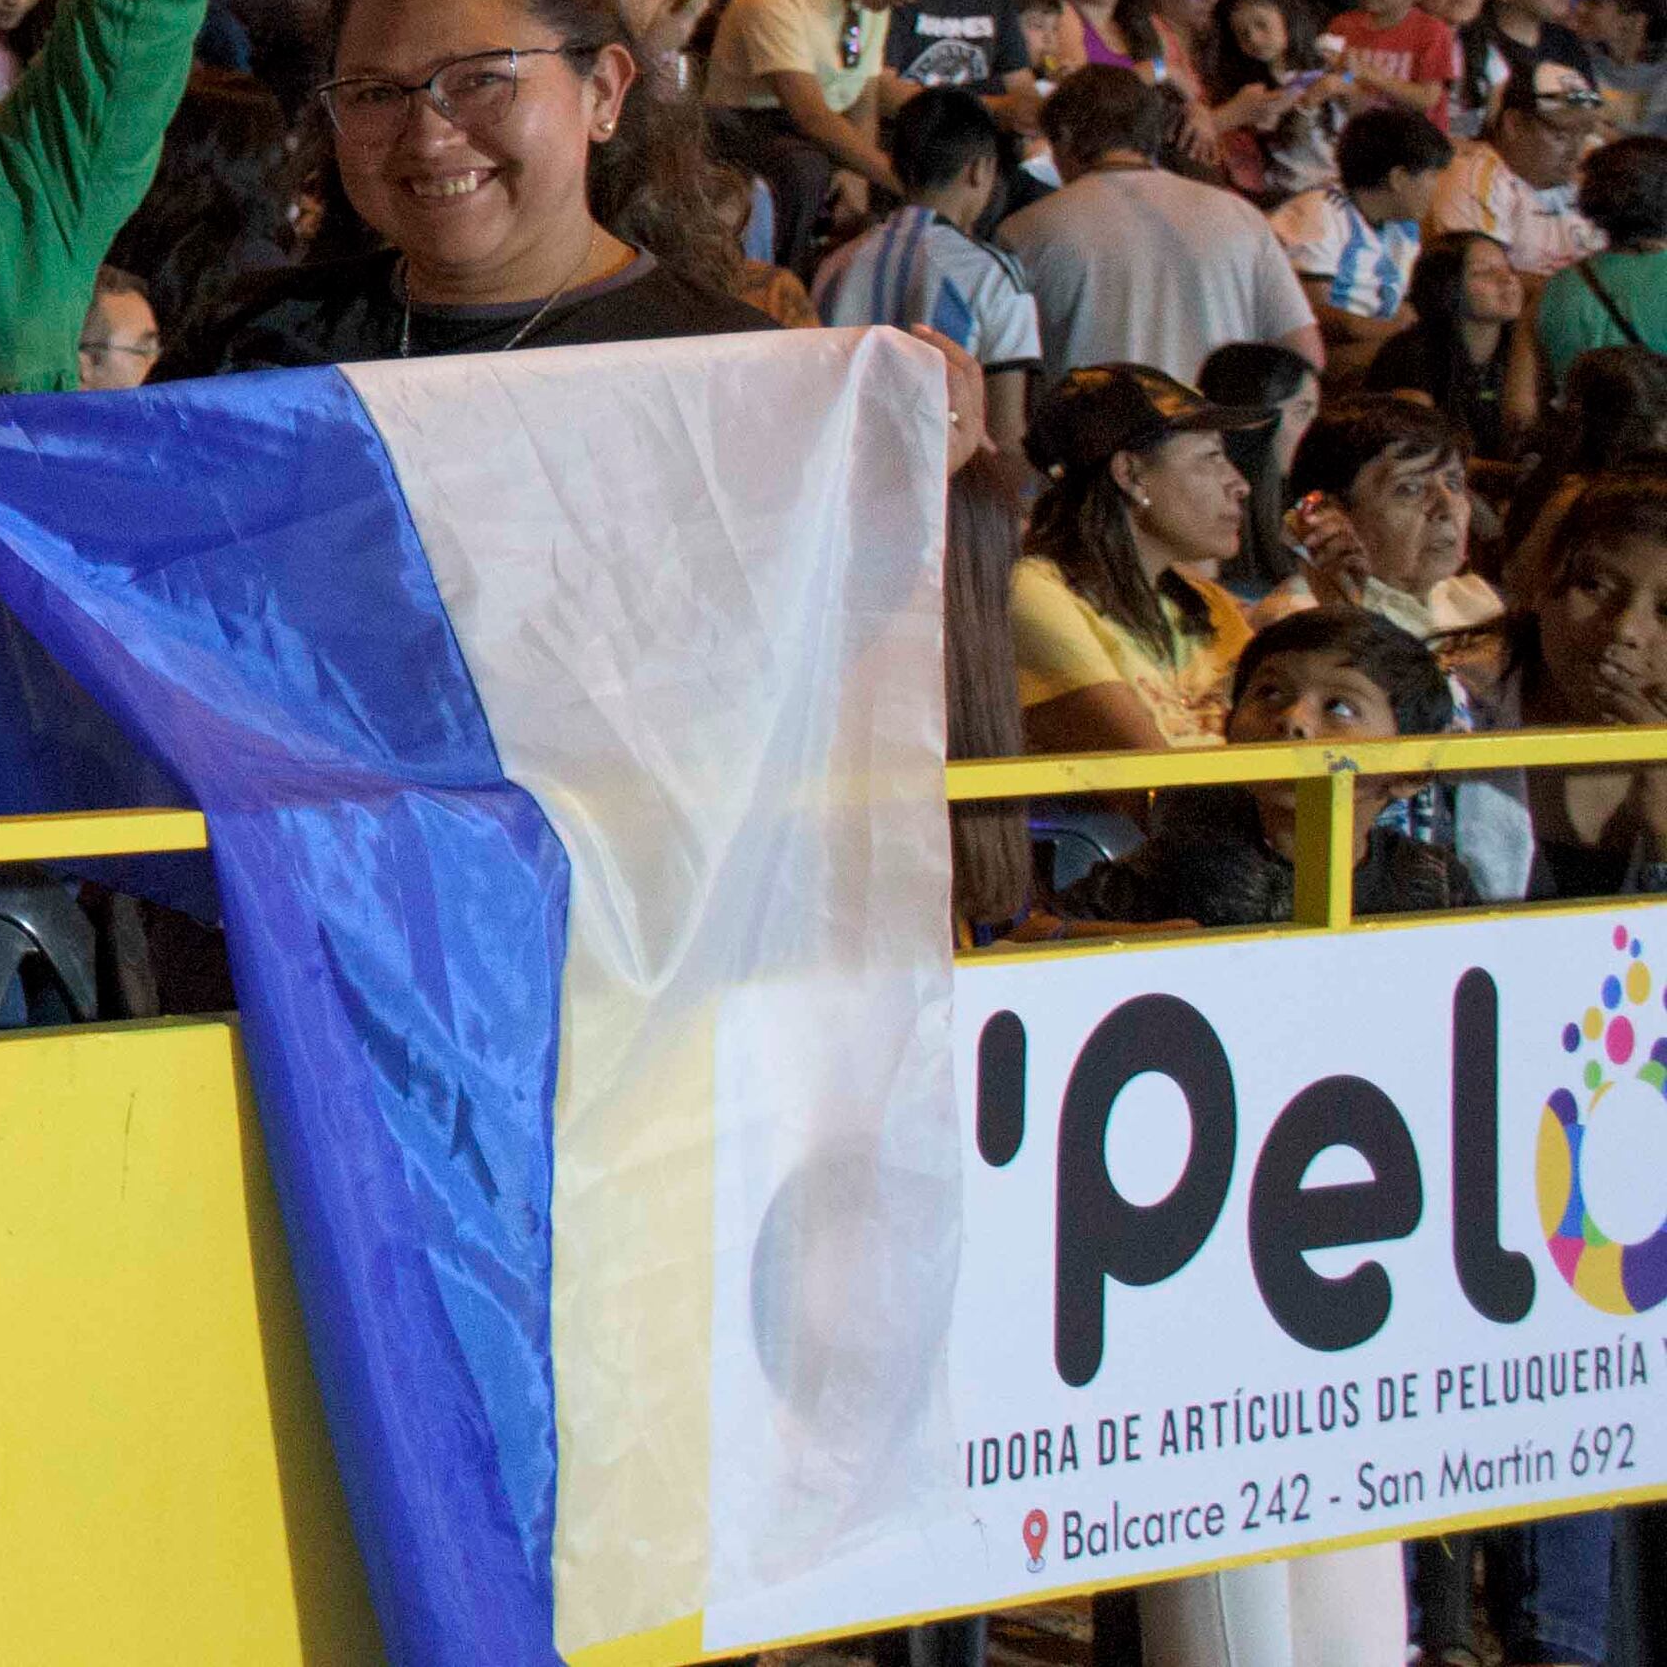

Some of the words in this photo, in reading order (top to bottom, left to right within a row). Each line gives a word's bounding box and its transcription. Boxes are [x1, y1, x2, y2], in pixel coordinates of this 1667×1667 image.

[965, 1423, 1079, 1488] IDORA
[1098, 1414, 1142, 1466] DE
[1159, 1380, 1361, 1457] ARTÍCULOS
[1376, 1372, 1418, 1423] DE
[1435, 1333, 1648, 1414] PELUQUERÍA
[1062, 1499, 1225, 1561] Balcarce
[1239, 1471, 1312, 1531] 242
[1357, 1460, 1424, 1511] San
[1438, 1439, 1555, 1497] Martín
[1569, 1421, 1636, 1476] 692
